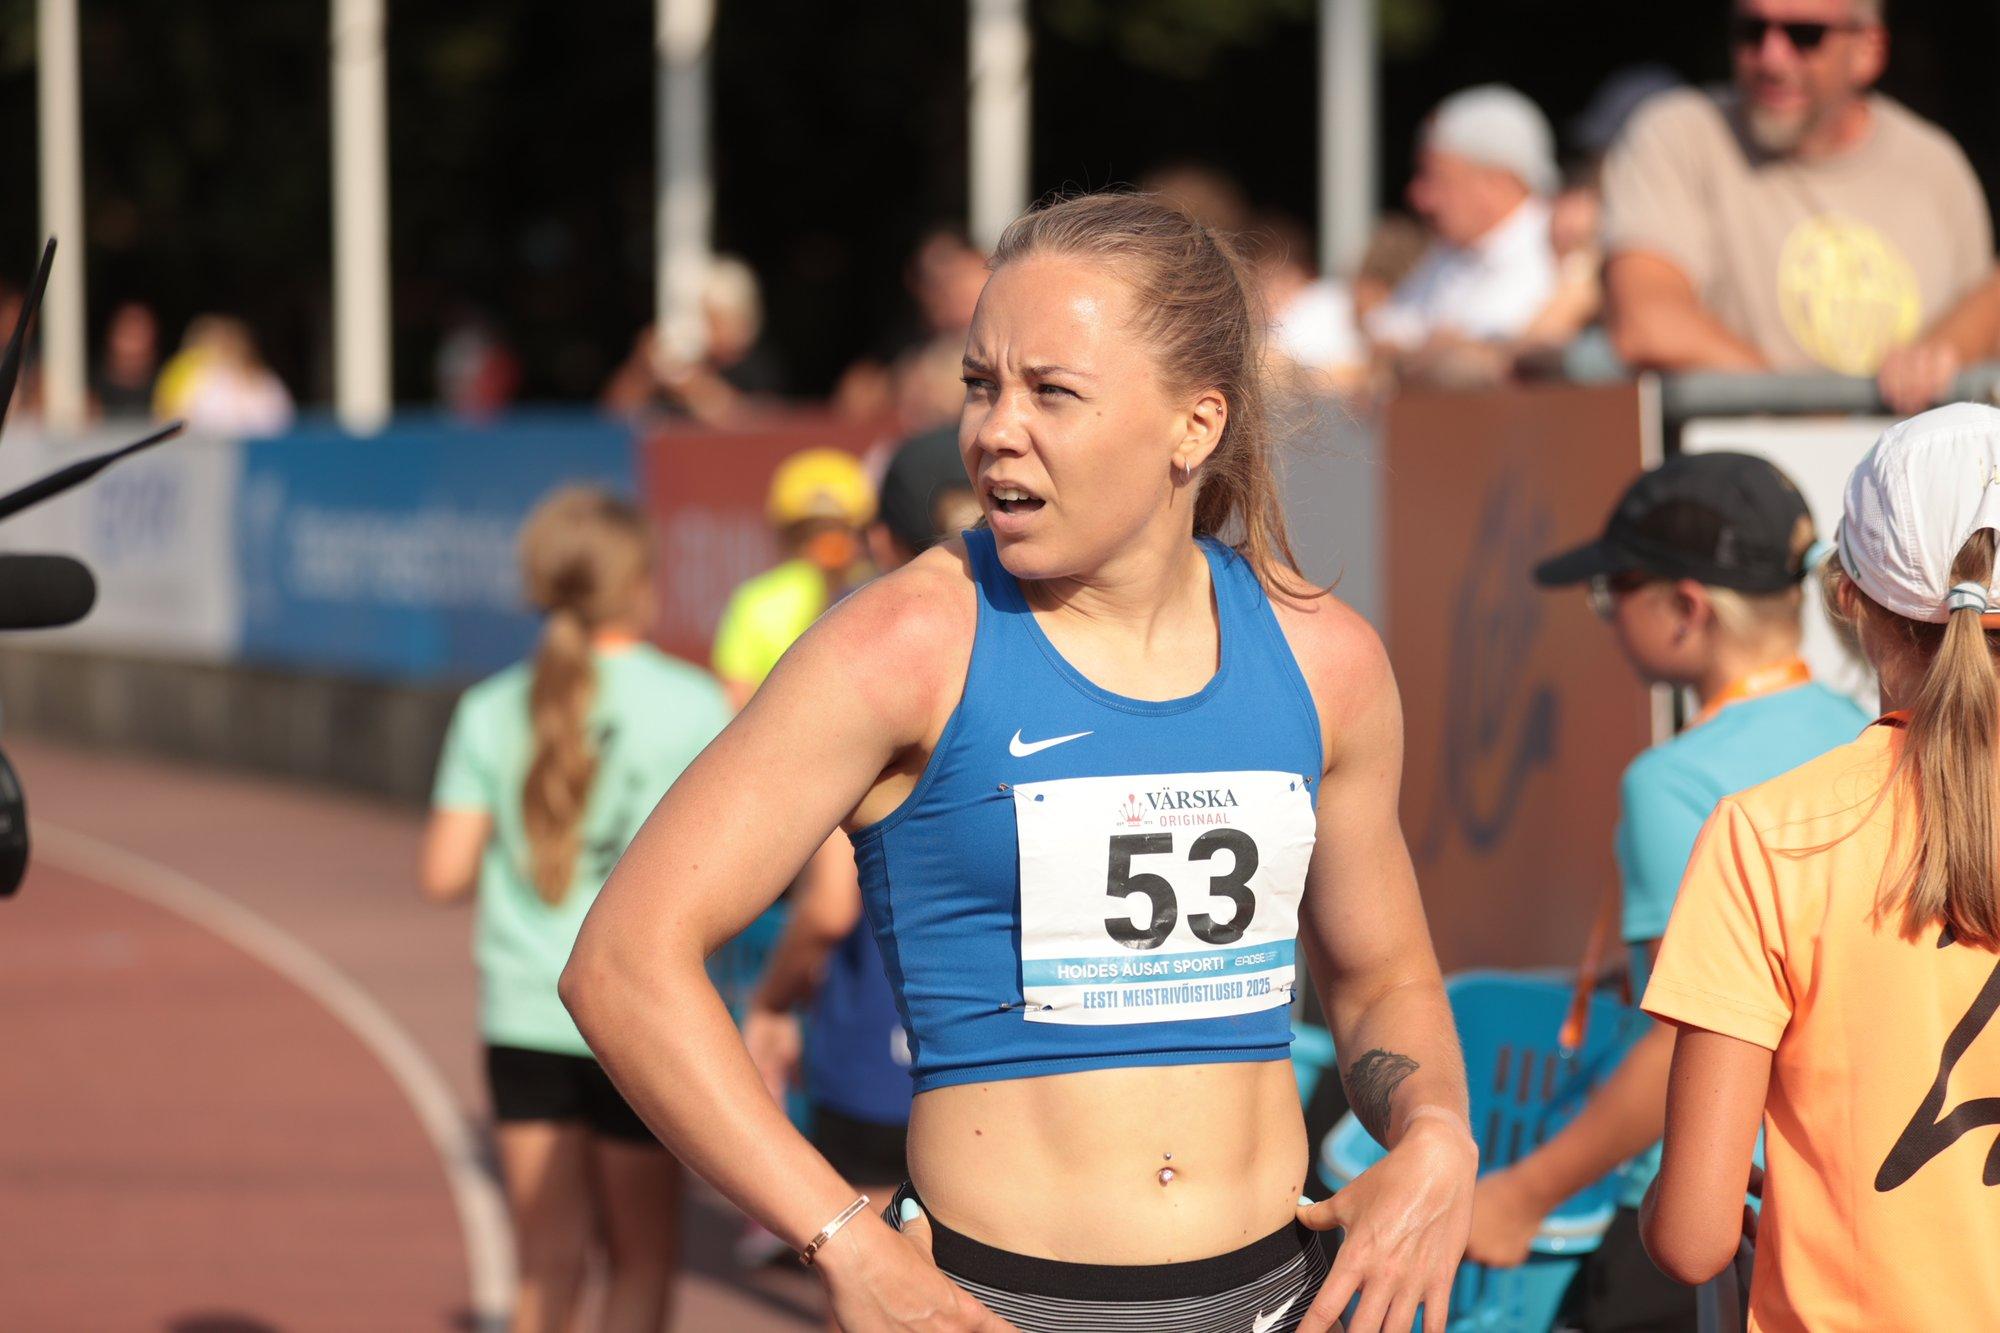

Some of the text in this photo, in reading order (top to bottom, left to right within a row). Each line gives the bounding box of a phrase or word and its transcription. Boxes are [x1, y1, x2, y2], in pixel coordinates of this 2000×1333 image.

[1145, 787, 1239, 810] VÄRSKA
[1160, 813, 1230, 827] ORIGINAAL
[1104, 828, 1259, 950] 53
[1057, 956, 1224, 979] HOIDES AUSAT SPORTI
[1083, 977, 1270, 1009] EESTI MEISTRIVÕISTLUSED 2025
